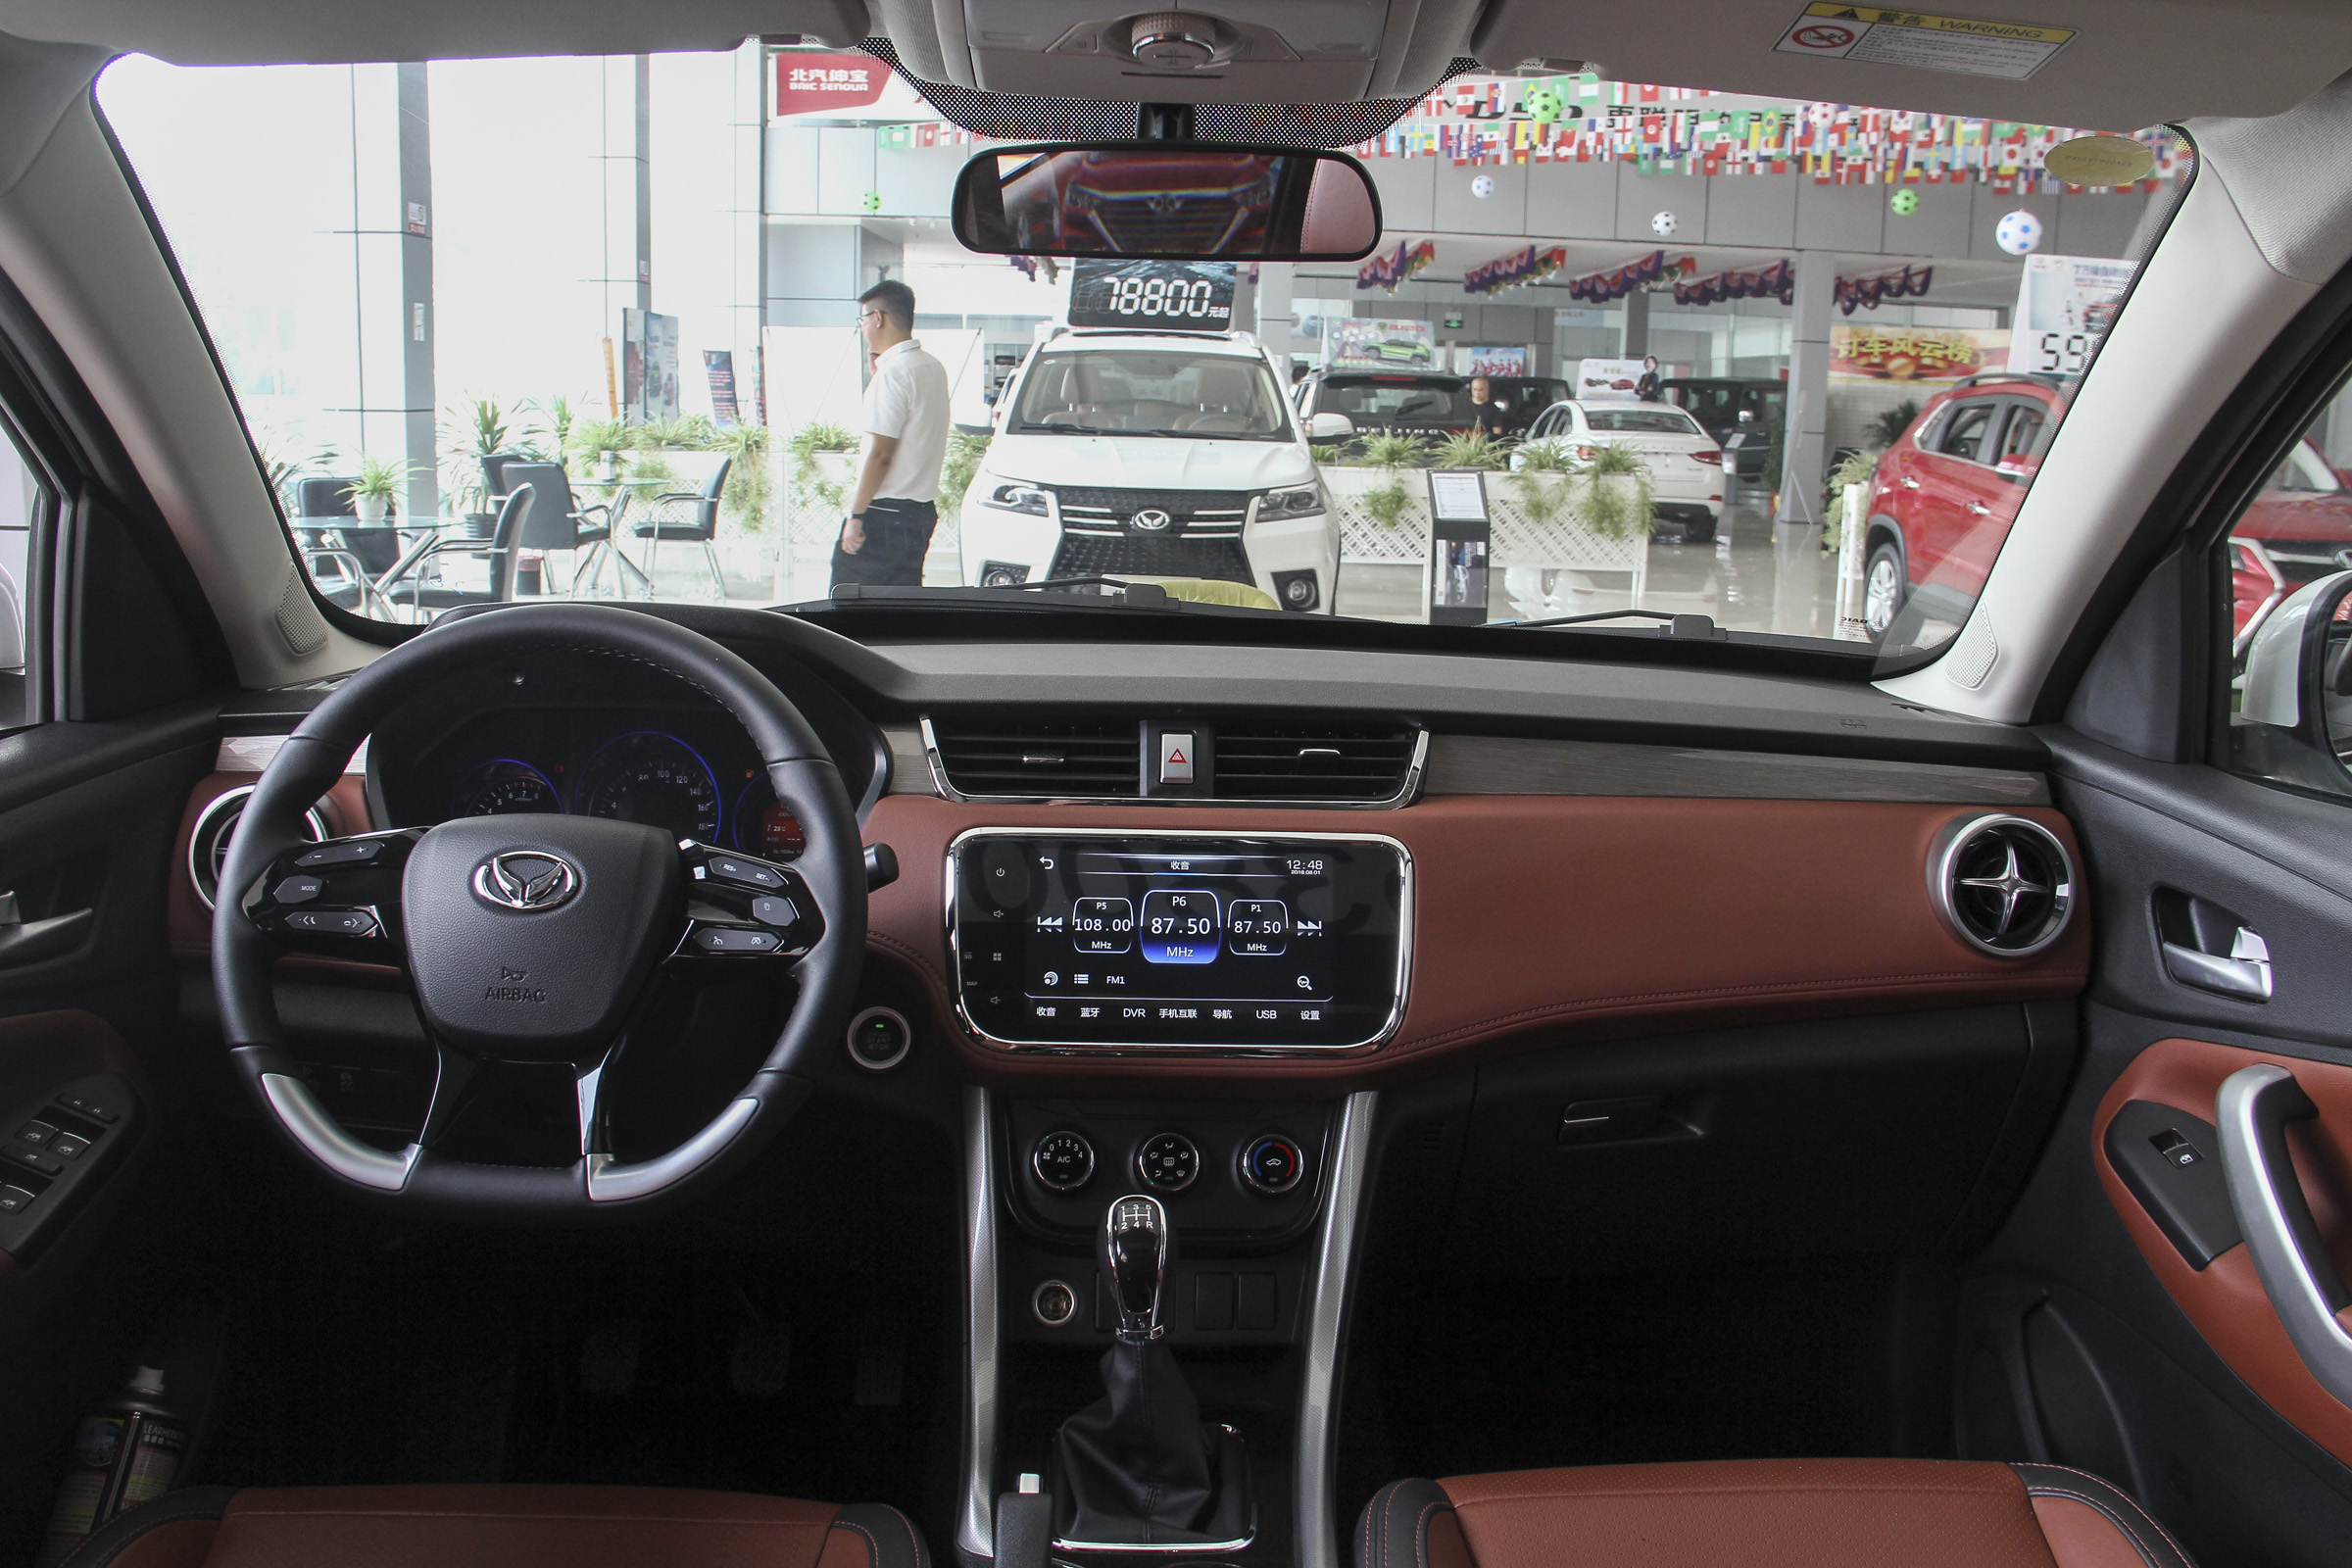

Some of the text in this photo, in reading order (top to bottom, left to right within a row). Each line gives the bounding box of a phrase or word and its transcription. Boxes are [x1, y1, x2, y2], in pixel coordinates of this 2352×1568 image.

[1939, 20, 2043, 38] WARNING
[789, 68, 869, 82] 北汽绅宝
[1835, 336, 1974, 365] 订车风云榜
[1170, 860, 1190, 870] 收音
[1286, 860, 1323, 870] 12:48
[1172, 896, 1187, 906] P6
[1074, 919, 1131, 931] 108.00
[1151, 917, 1211, 935] 87.50
[1234, 920, 1282, 934] 87.50
[1092, 941, 1111, 950] MHz
[1248, 943, 1267, 952] MHz
[1166, 947, 1195, 957] MHz
[485, 988, 547, 1003] AIRBAG
[1036, 1006, 1056, 1017] 收音
[1080, 1007, 1101, 1017] 蓝牙
[1123, 1008, 1146, 1018] DVR
[1158, 1008, 1198, 1018] 手机互联
[1212, 1009, 1233, 1019] 导航
[1256, 1009, 1277, 1019] USB
[1299, 1010, 1320, 1020] 设置
